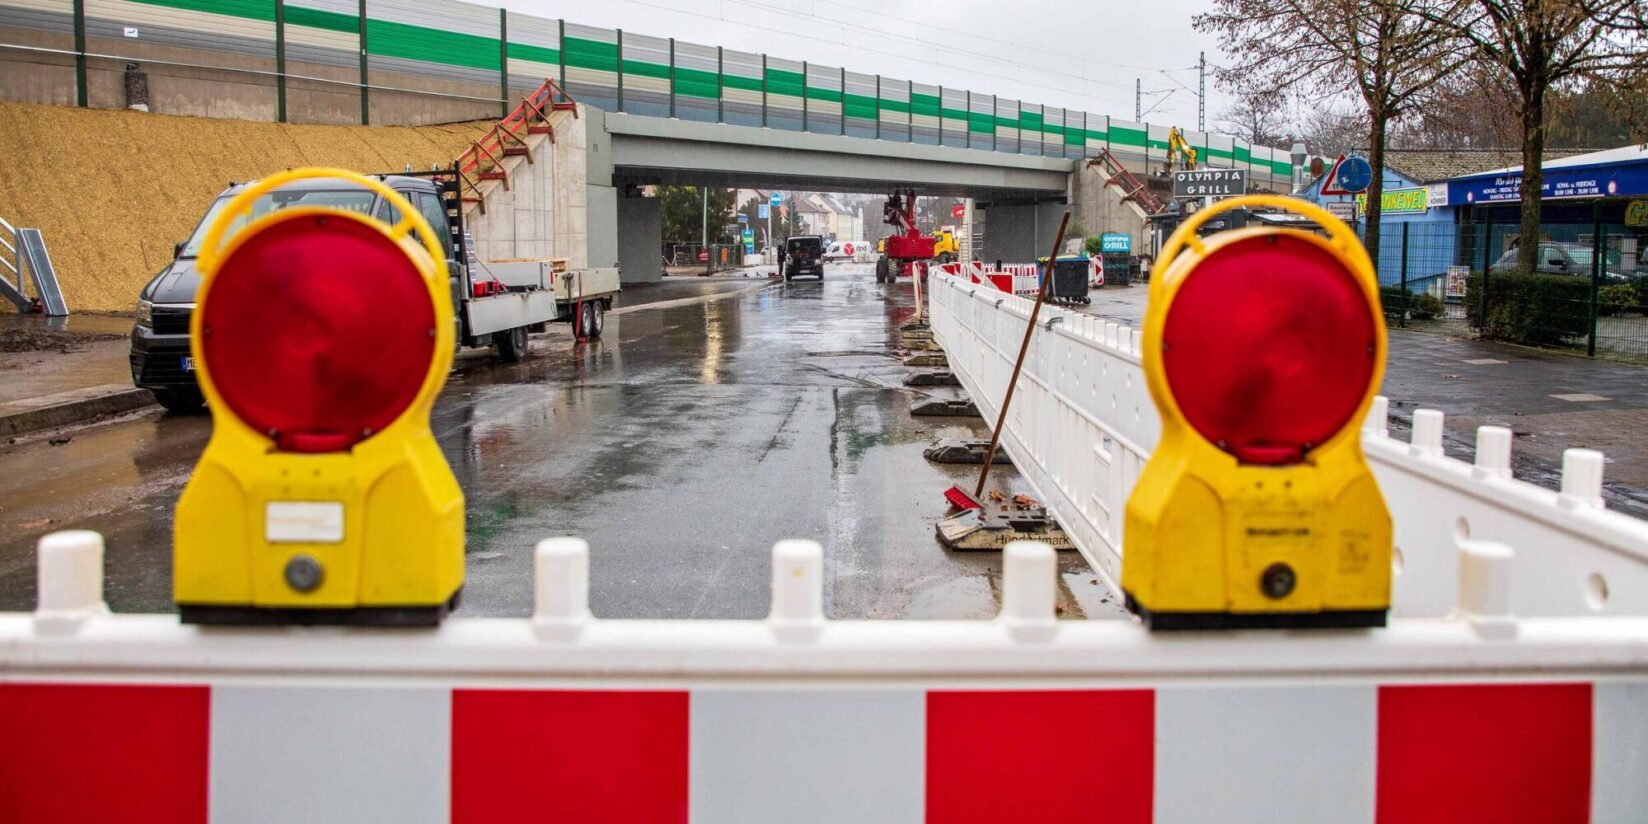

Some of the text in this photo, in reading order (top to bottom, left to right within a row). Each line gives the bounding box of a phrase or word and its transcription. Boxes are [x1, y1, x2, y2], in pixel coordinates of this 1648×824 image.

[1177, 171, 1241, 182] OLYMPIA
[1187, 184, 1230, 194] GRILL
[1103, 241, 1129, 249] GRILL
